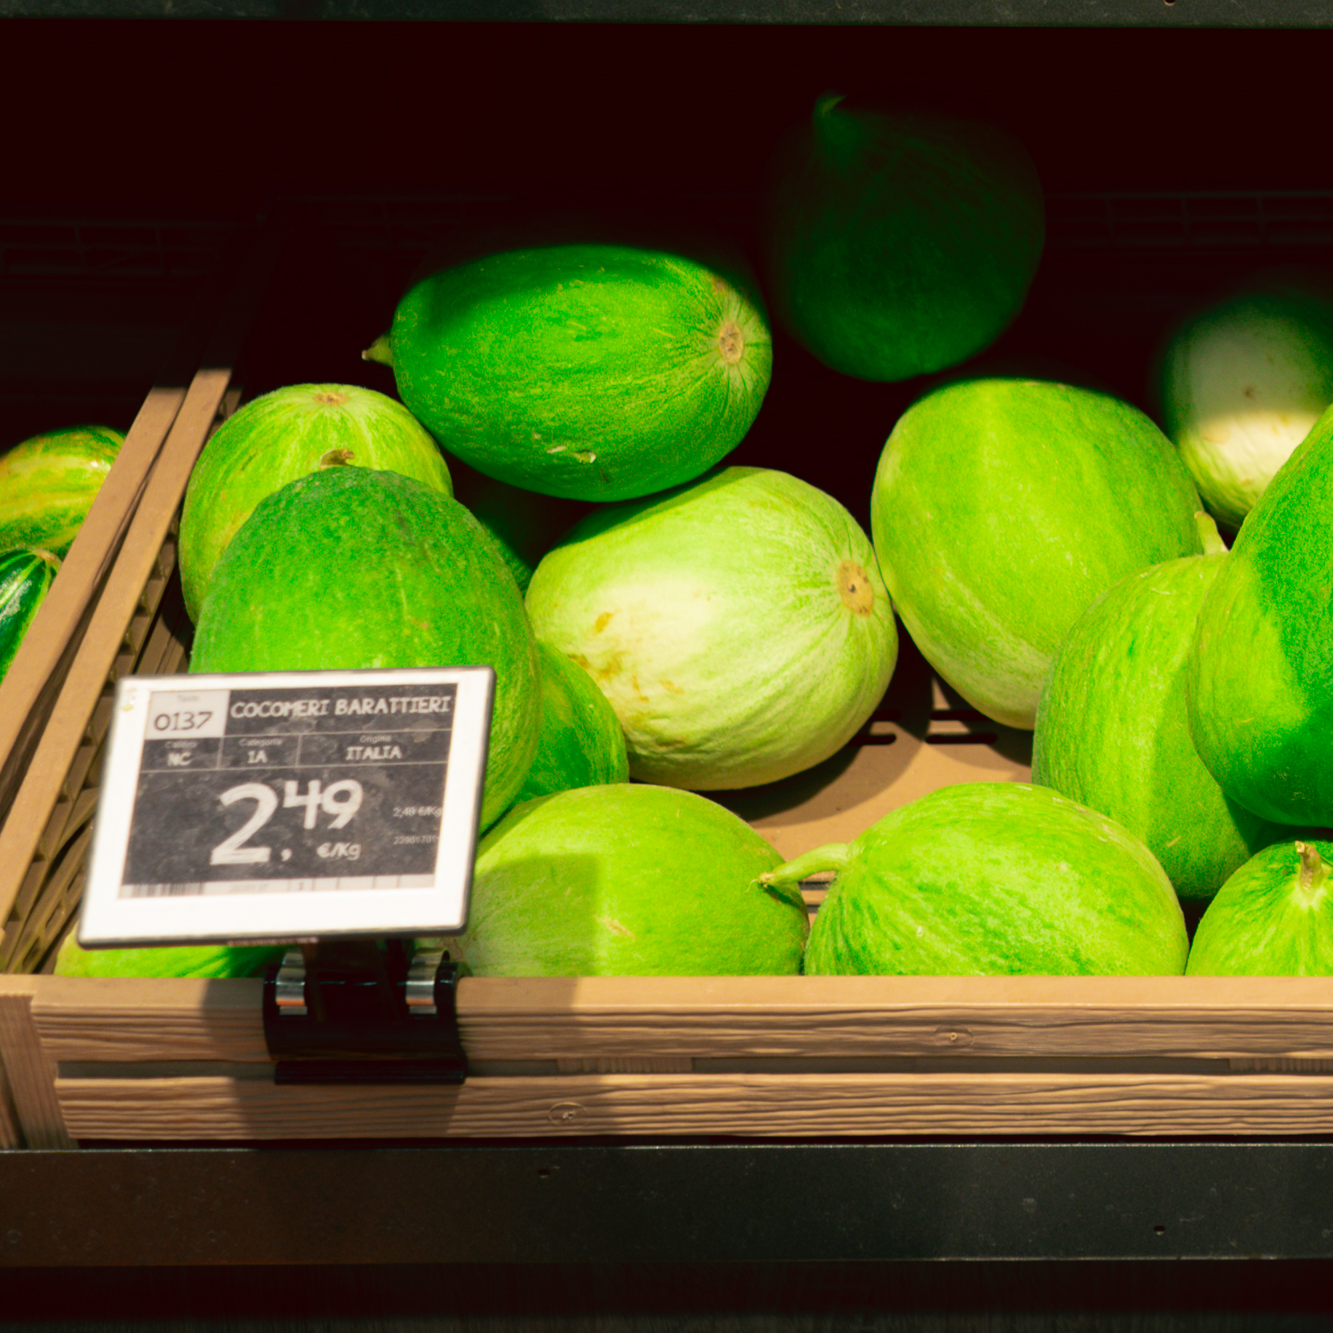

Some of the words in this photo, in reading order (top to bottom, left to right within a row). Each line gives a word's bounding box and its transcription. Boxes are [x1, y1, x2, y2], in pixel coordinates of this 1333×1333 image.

[230, 699, 330, 719] COCOMERI
[335, 695, 452, 716] BARATTIERI
[153, 711, 213, 732] 0137
[166, 751, 192, 766] NC
[345, 745, 403, 761] ITALIA
[316, 842, 361, 861] €/Kg
